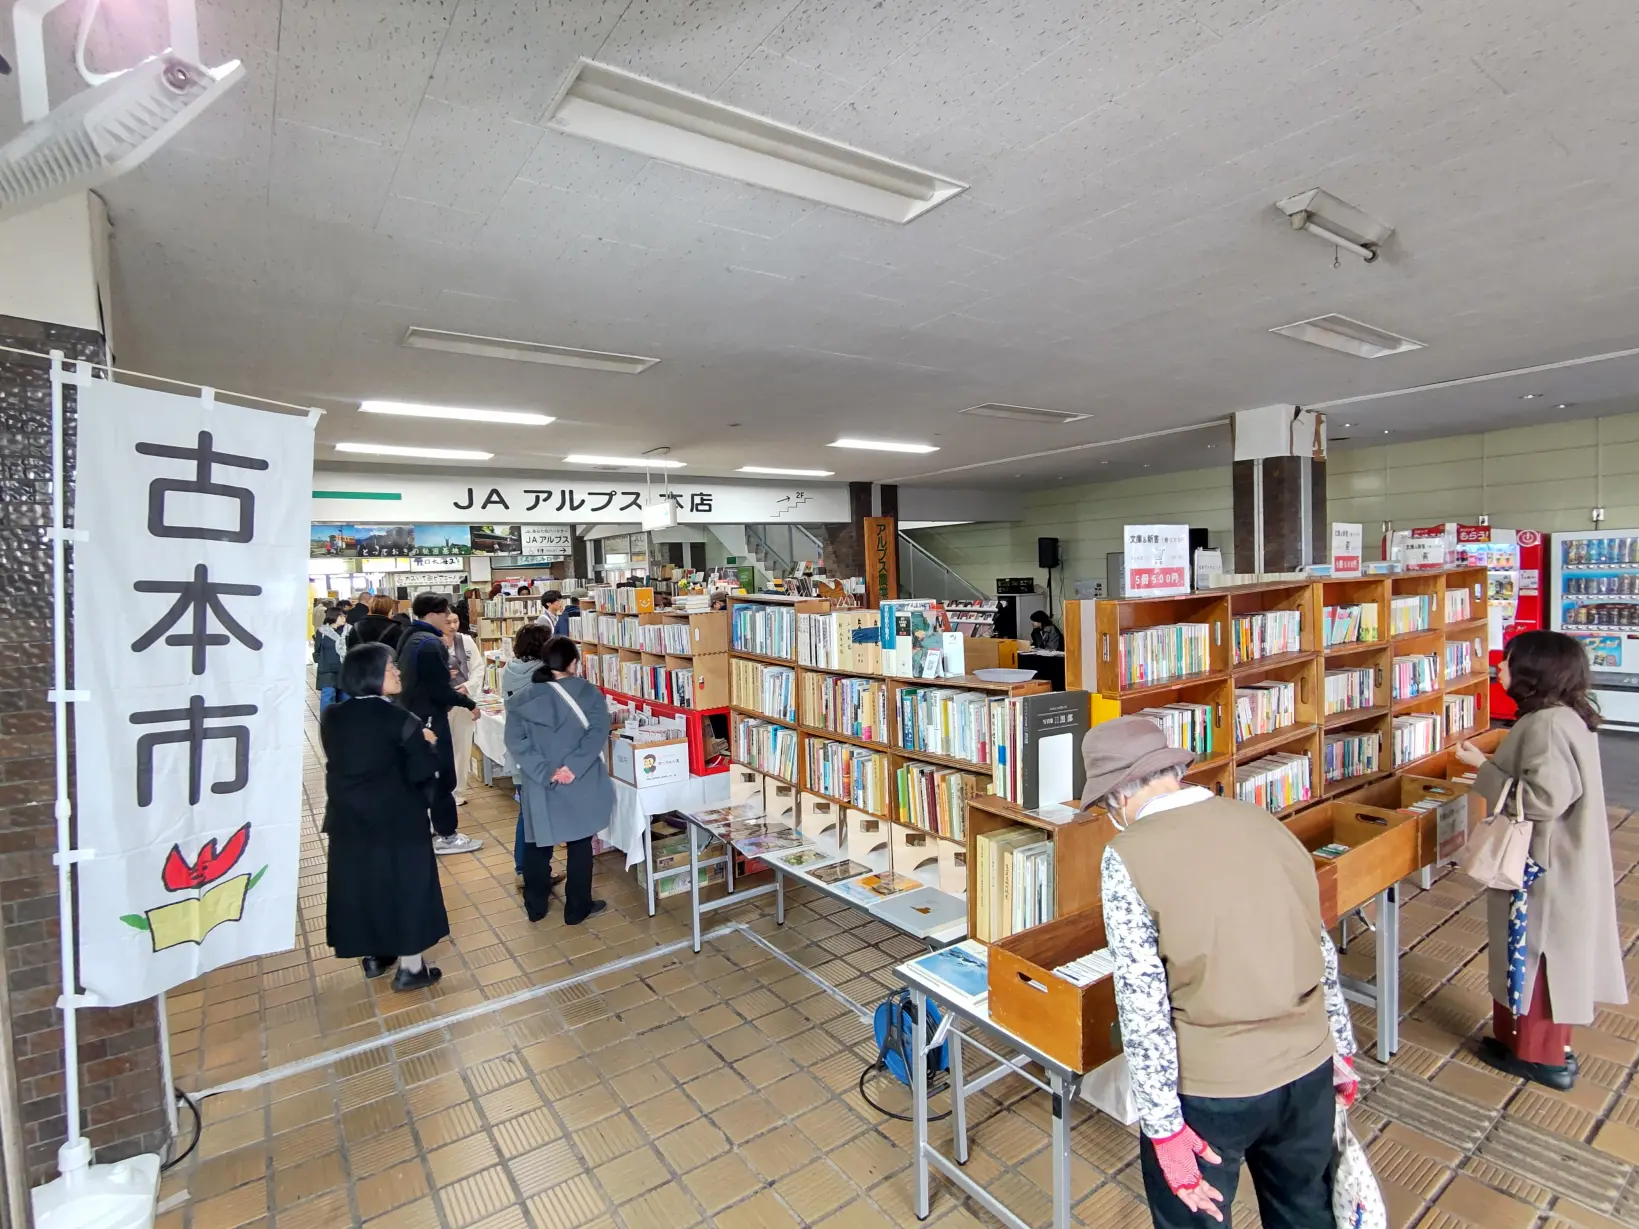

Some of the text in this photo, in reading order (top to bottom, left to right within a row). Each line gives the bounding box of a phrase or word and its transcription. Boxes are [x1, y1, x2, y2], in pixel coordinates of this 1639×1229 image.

[453, 487, 510, 510] JA
[523, 489, 642, 512] アルプス
[795, 491, 805, 499] 2F
[526, 536, 570, 544] JA アルプス
[129, 430, 269, 808] 古本市
